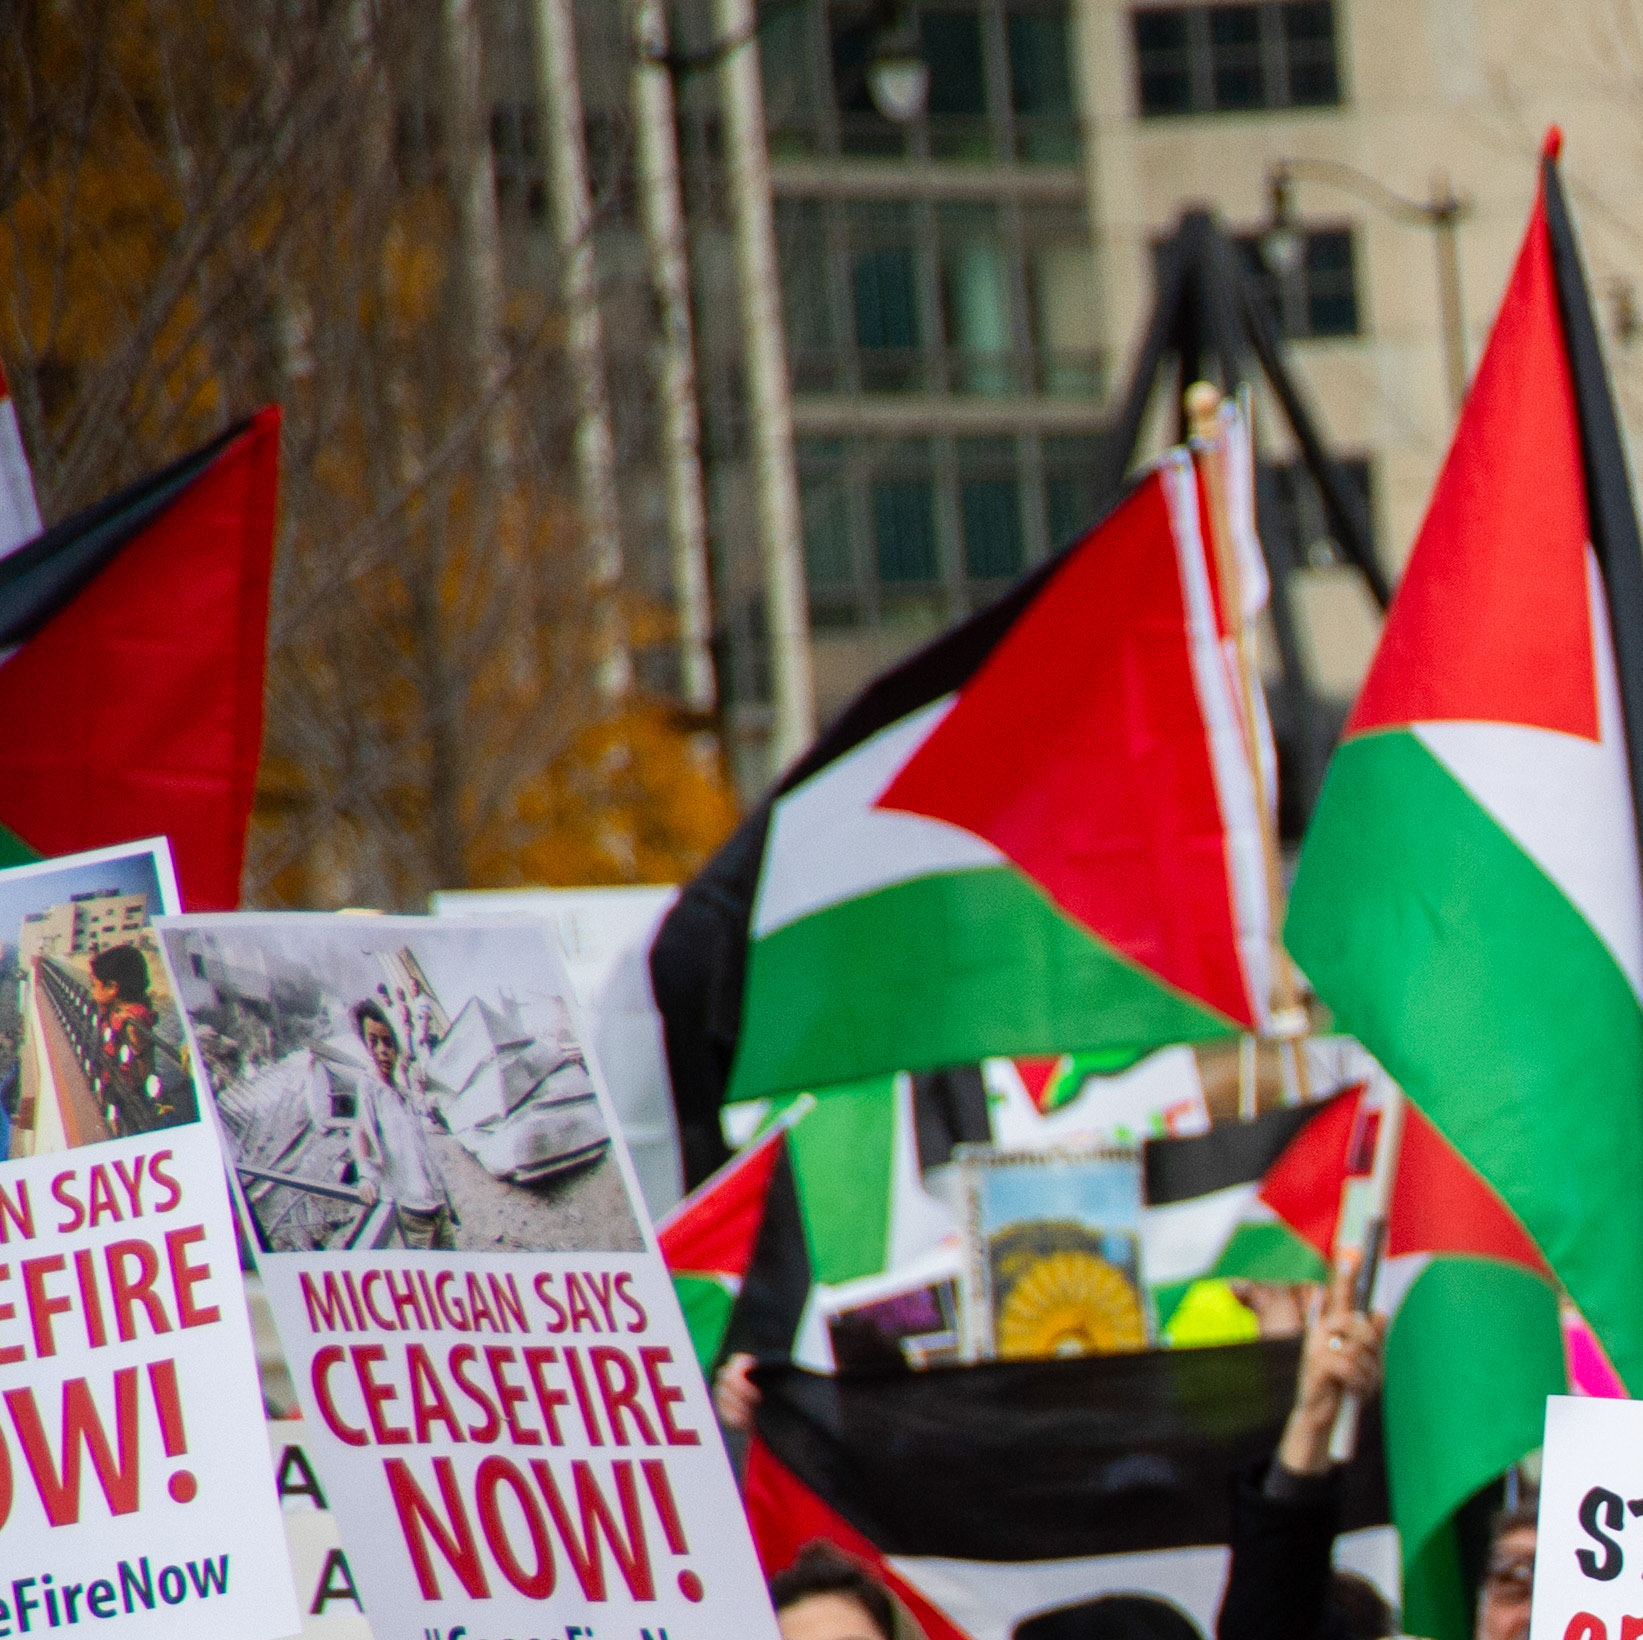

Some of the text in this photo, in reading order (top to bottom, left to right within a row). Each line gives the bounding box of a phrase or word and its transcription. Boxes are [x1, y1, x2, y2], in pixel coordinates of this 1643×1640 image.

[50, 1149, 182, 1233] SAYS
[299, 1271, 648, 1335] MICHIGAN SAYS
[311, 1345, 699, 1447] CEASEFIRE
[383, 1455, 705, 1603] NOW!
